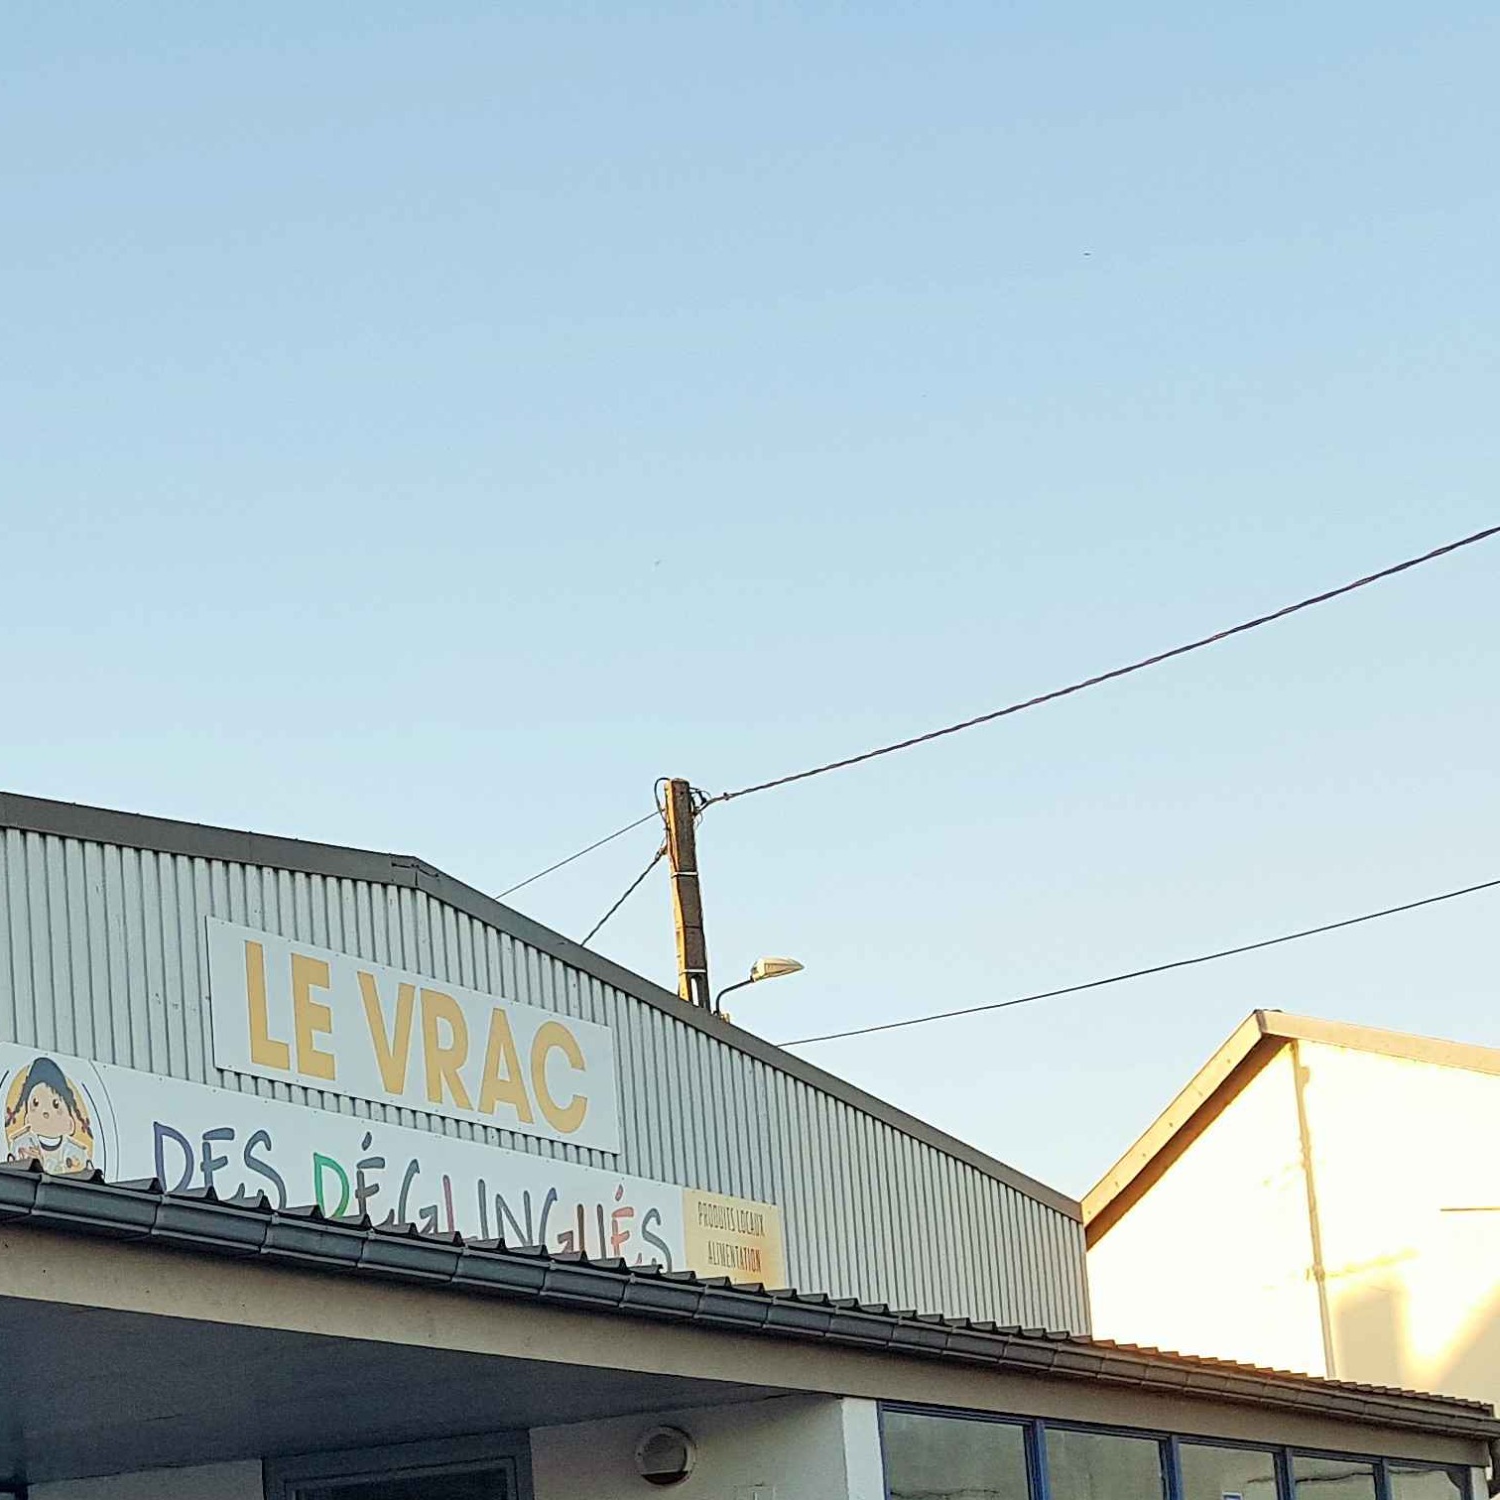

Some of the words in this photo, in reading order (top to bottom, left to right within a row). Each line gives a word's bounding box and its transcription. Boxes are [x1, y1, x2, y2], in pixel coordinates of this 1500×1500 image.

[245, 940, 336, 1081] LE
[357, 971, 588, 1134] VRAC
[153, 1121, 287, 1210] DES
[697, 1201, 735, 1232] PRODUITS
[736, 1207, 765, 1237] LOCAUX
[708, 1240, 762, 1273] ALIMENTATION
